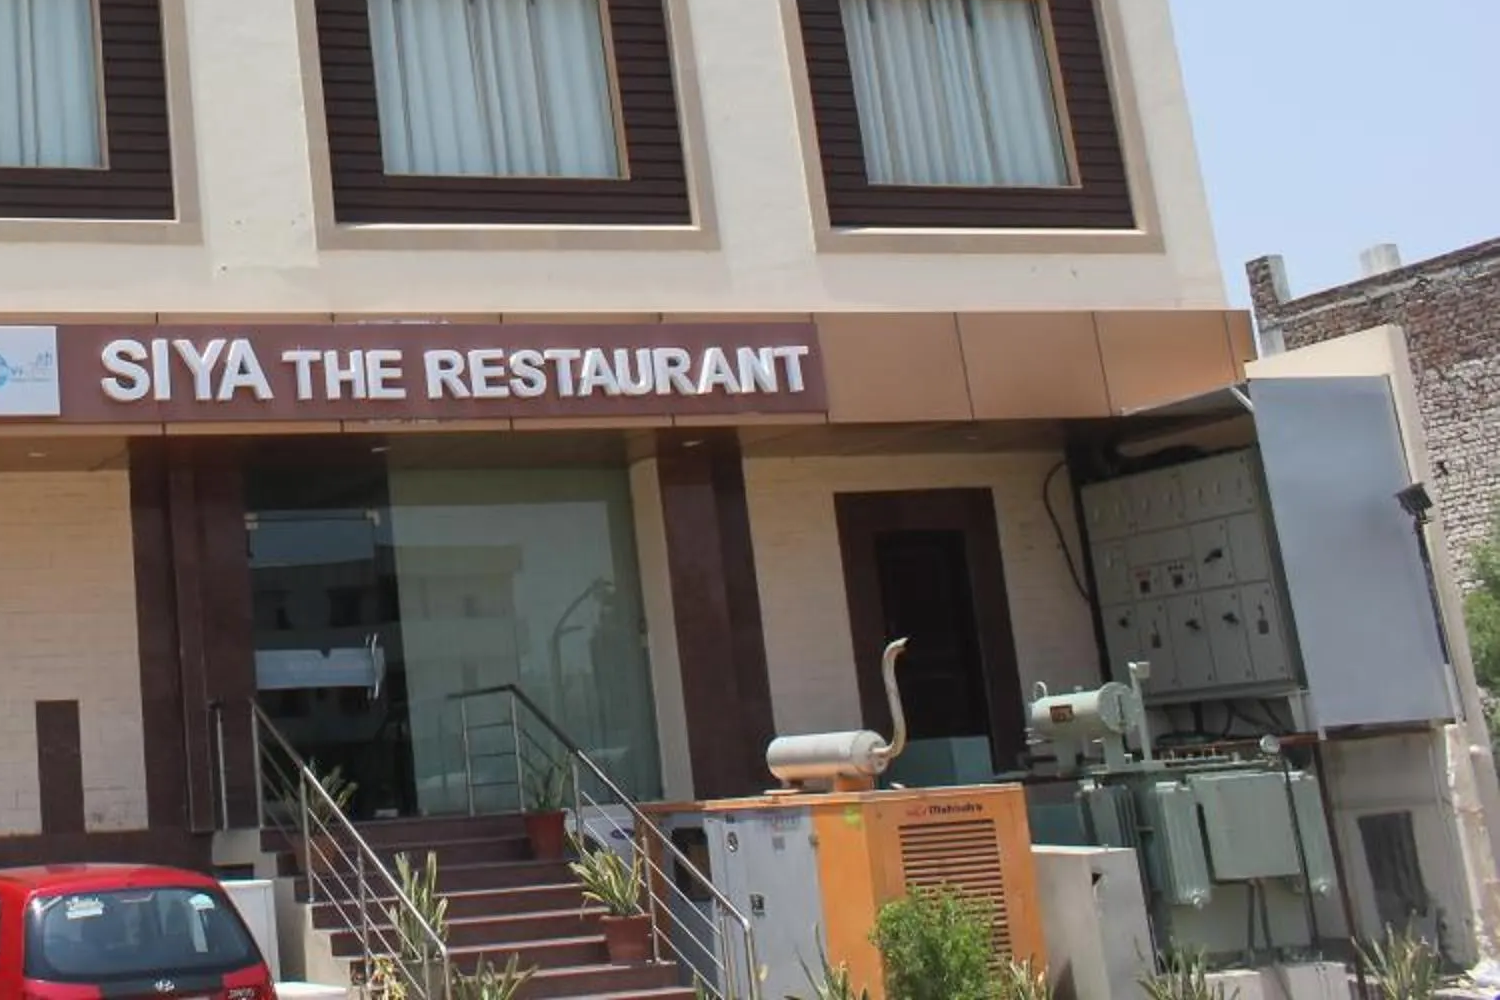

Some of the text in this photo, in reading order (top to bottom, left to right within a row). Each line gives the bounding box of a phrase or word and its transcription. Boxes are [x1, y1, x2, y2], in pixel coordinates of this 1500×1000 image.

[100, 337, 274, 402] SIYA
[282, 348, 406, 401] THE
[423, 345, 809, 400] RESTAURANT
